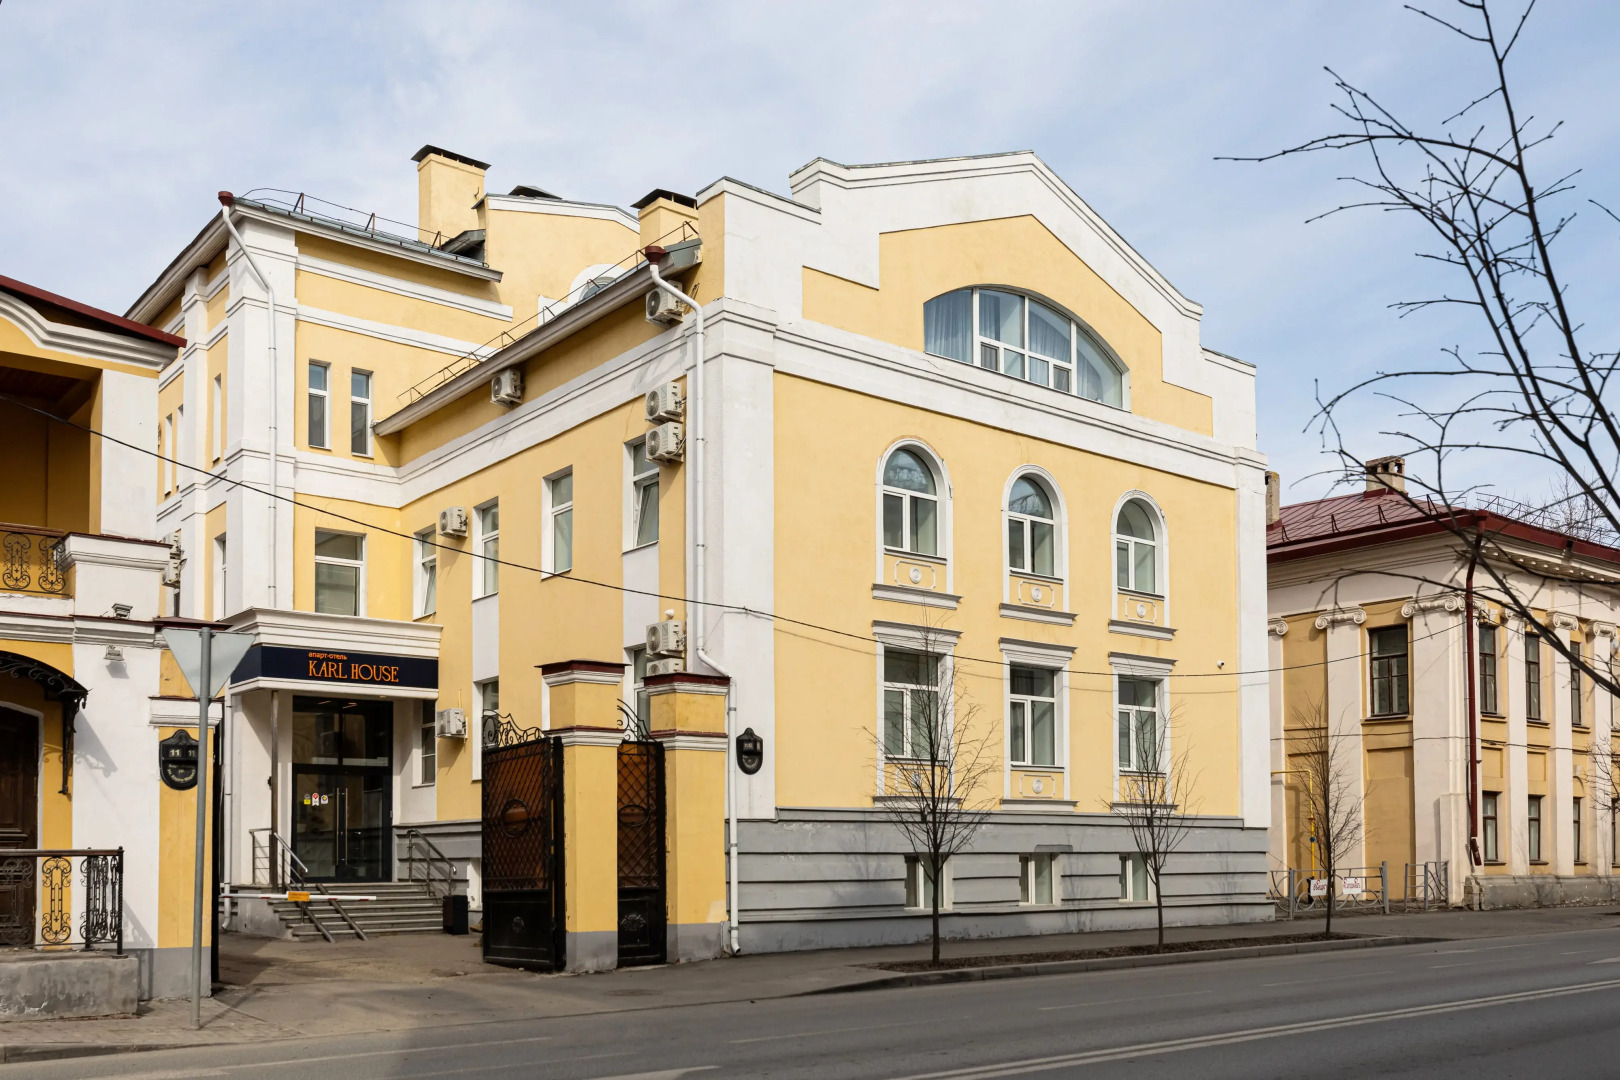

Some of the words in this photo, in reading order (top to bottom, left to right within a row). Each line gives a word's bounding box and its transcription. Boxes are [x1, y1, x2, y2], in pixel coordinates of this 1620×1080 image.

[308, 652, 347, 660] апарт-отель
[308, 660, 347, 679] KARL
[351, 663, 399, 682] HOUSE
